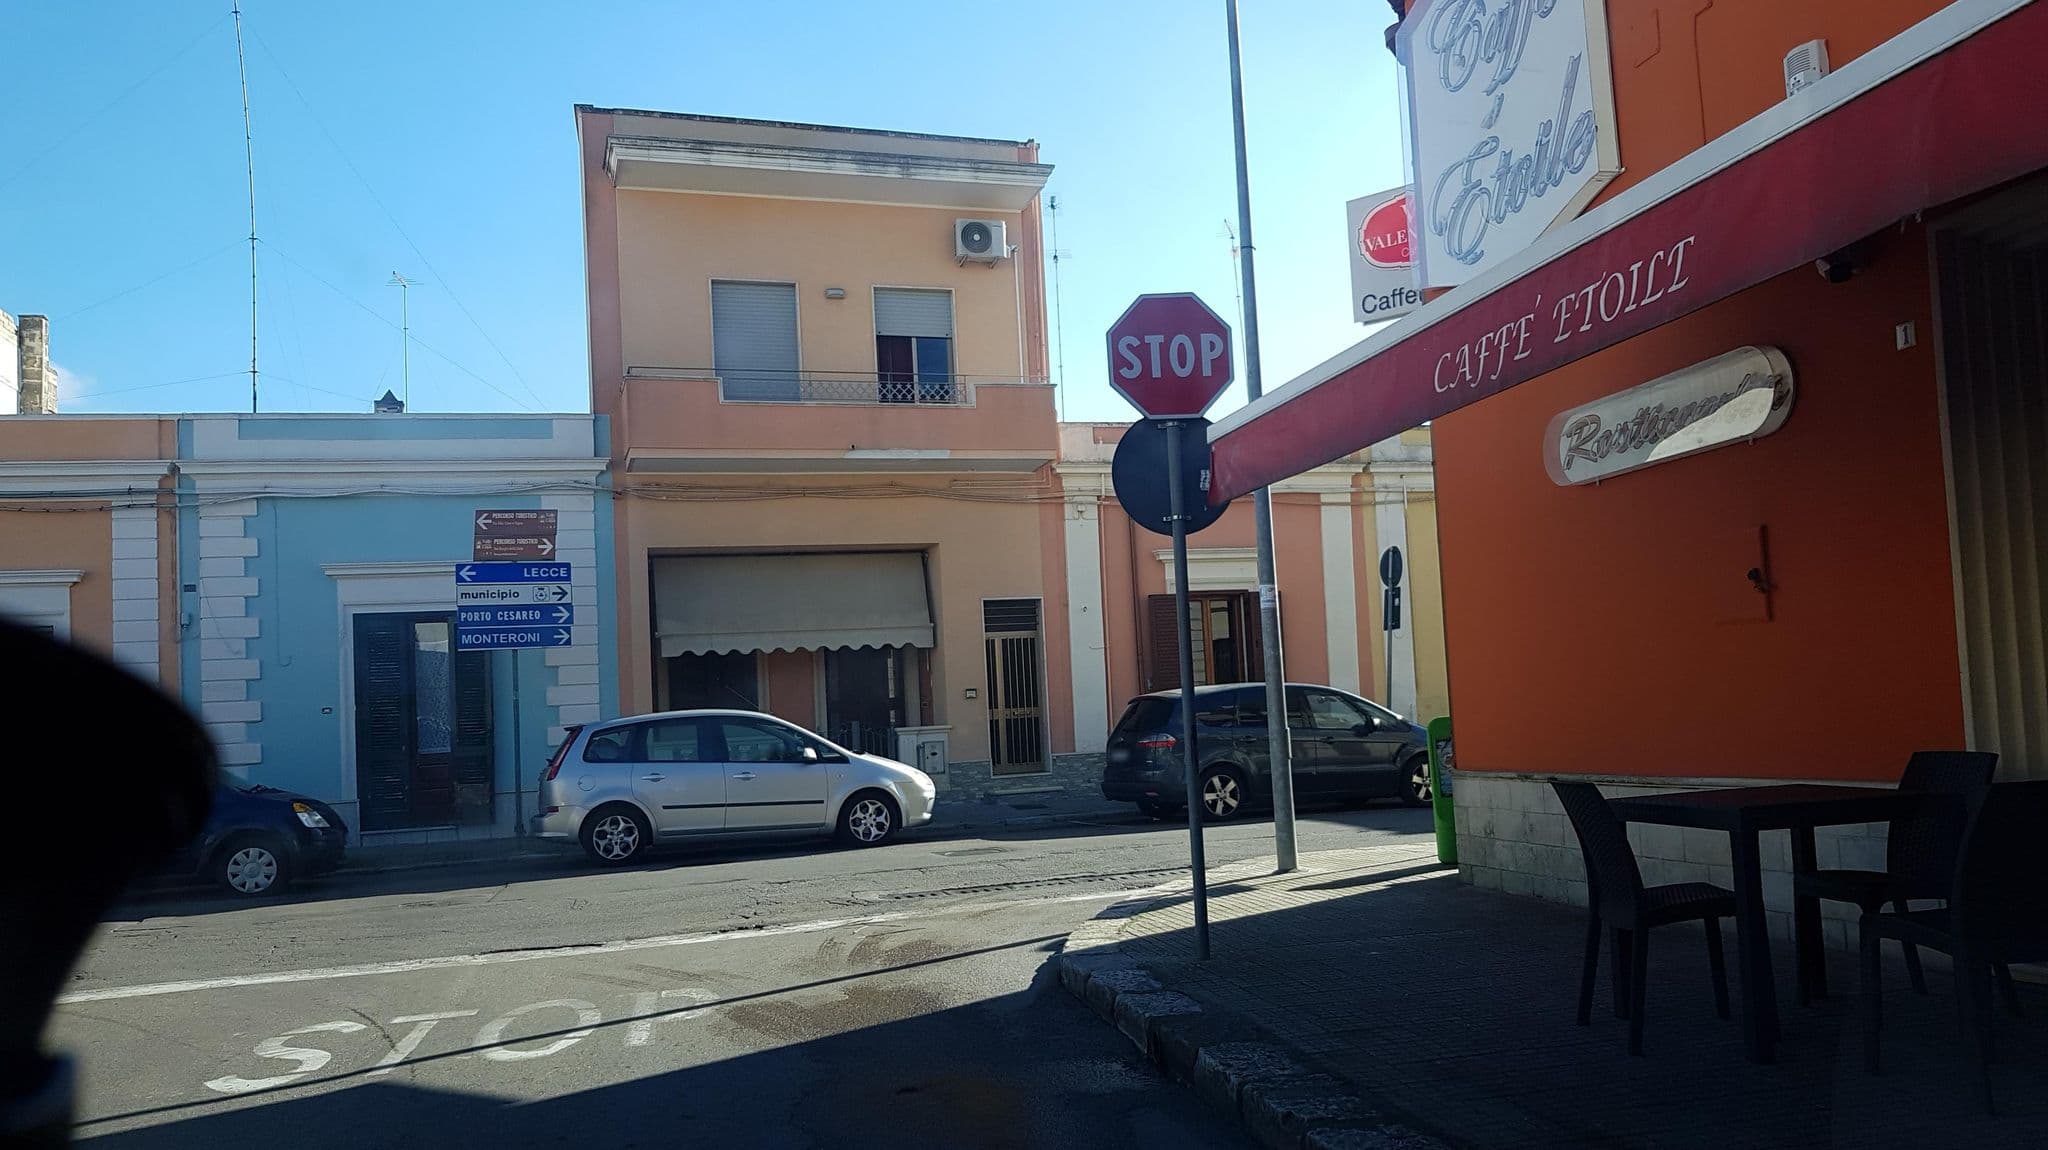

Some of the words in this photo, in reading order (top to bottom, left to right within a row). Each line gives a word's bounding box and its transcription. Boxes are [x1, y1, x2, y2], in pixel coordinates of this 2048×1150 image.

[1902, 325, 1910, 345] 1
[1118, 333, 1224, 379] STOP
[523, 567, 568, 577] LECCE
[460, 589, 520, 600] municipio
[460, 611, 491, 622] PORTO
[497, 610, 541, 621] CESAREO
[461, 632, 540, 645] MONTERONI
[204, 988, 720, 1094] STOP
